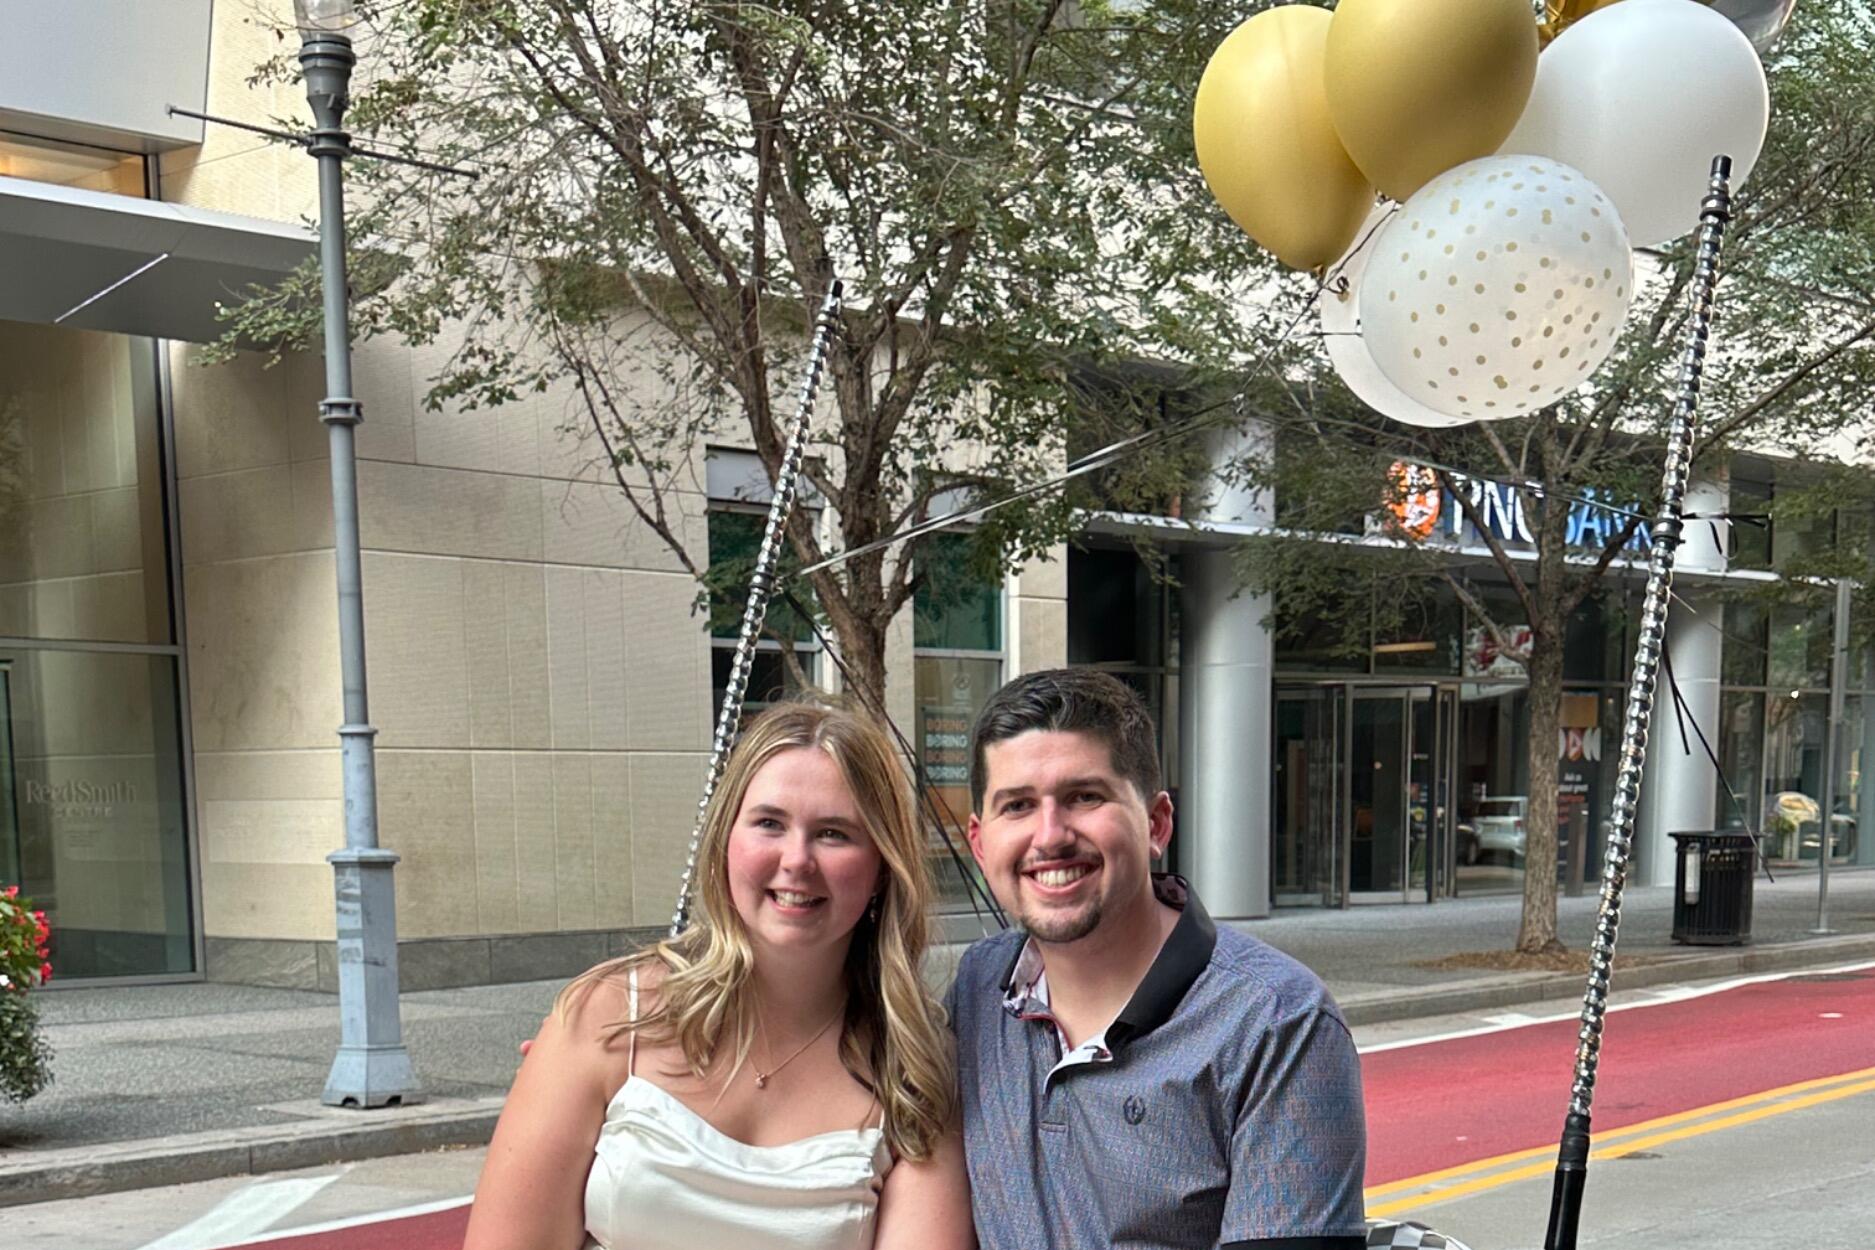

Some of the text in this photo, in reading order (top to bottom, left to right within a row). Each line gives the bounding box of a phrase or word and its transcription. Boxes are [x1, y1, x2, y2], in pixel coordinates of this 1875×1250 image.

[927, 719, 968, 732] BORING
[926, 734, 969, 748] BORING
[927, 765, 968, 780] BORING
